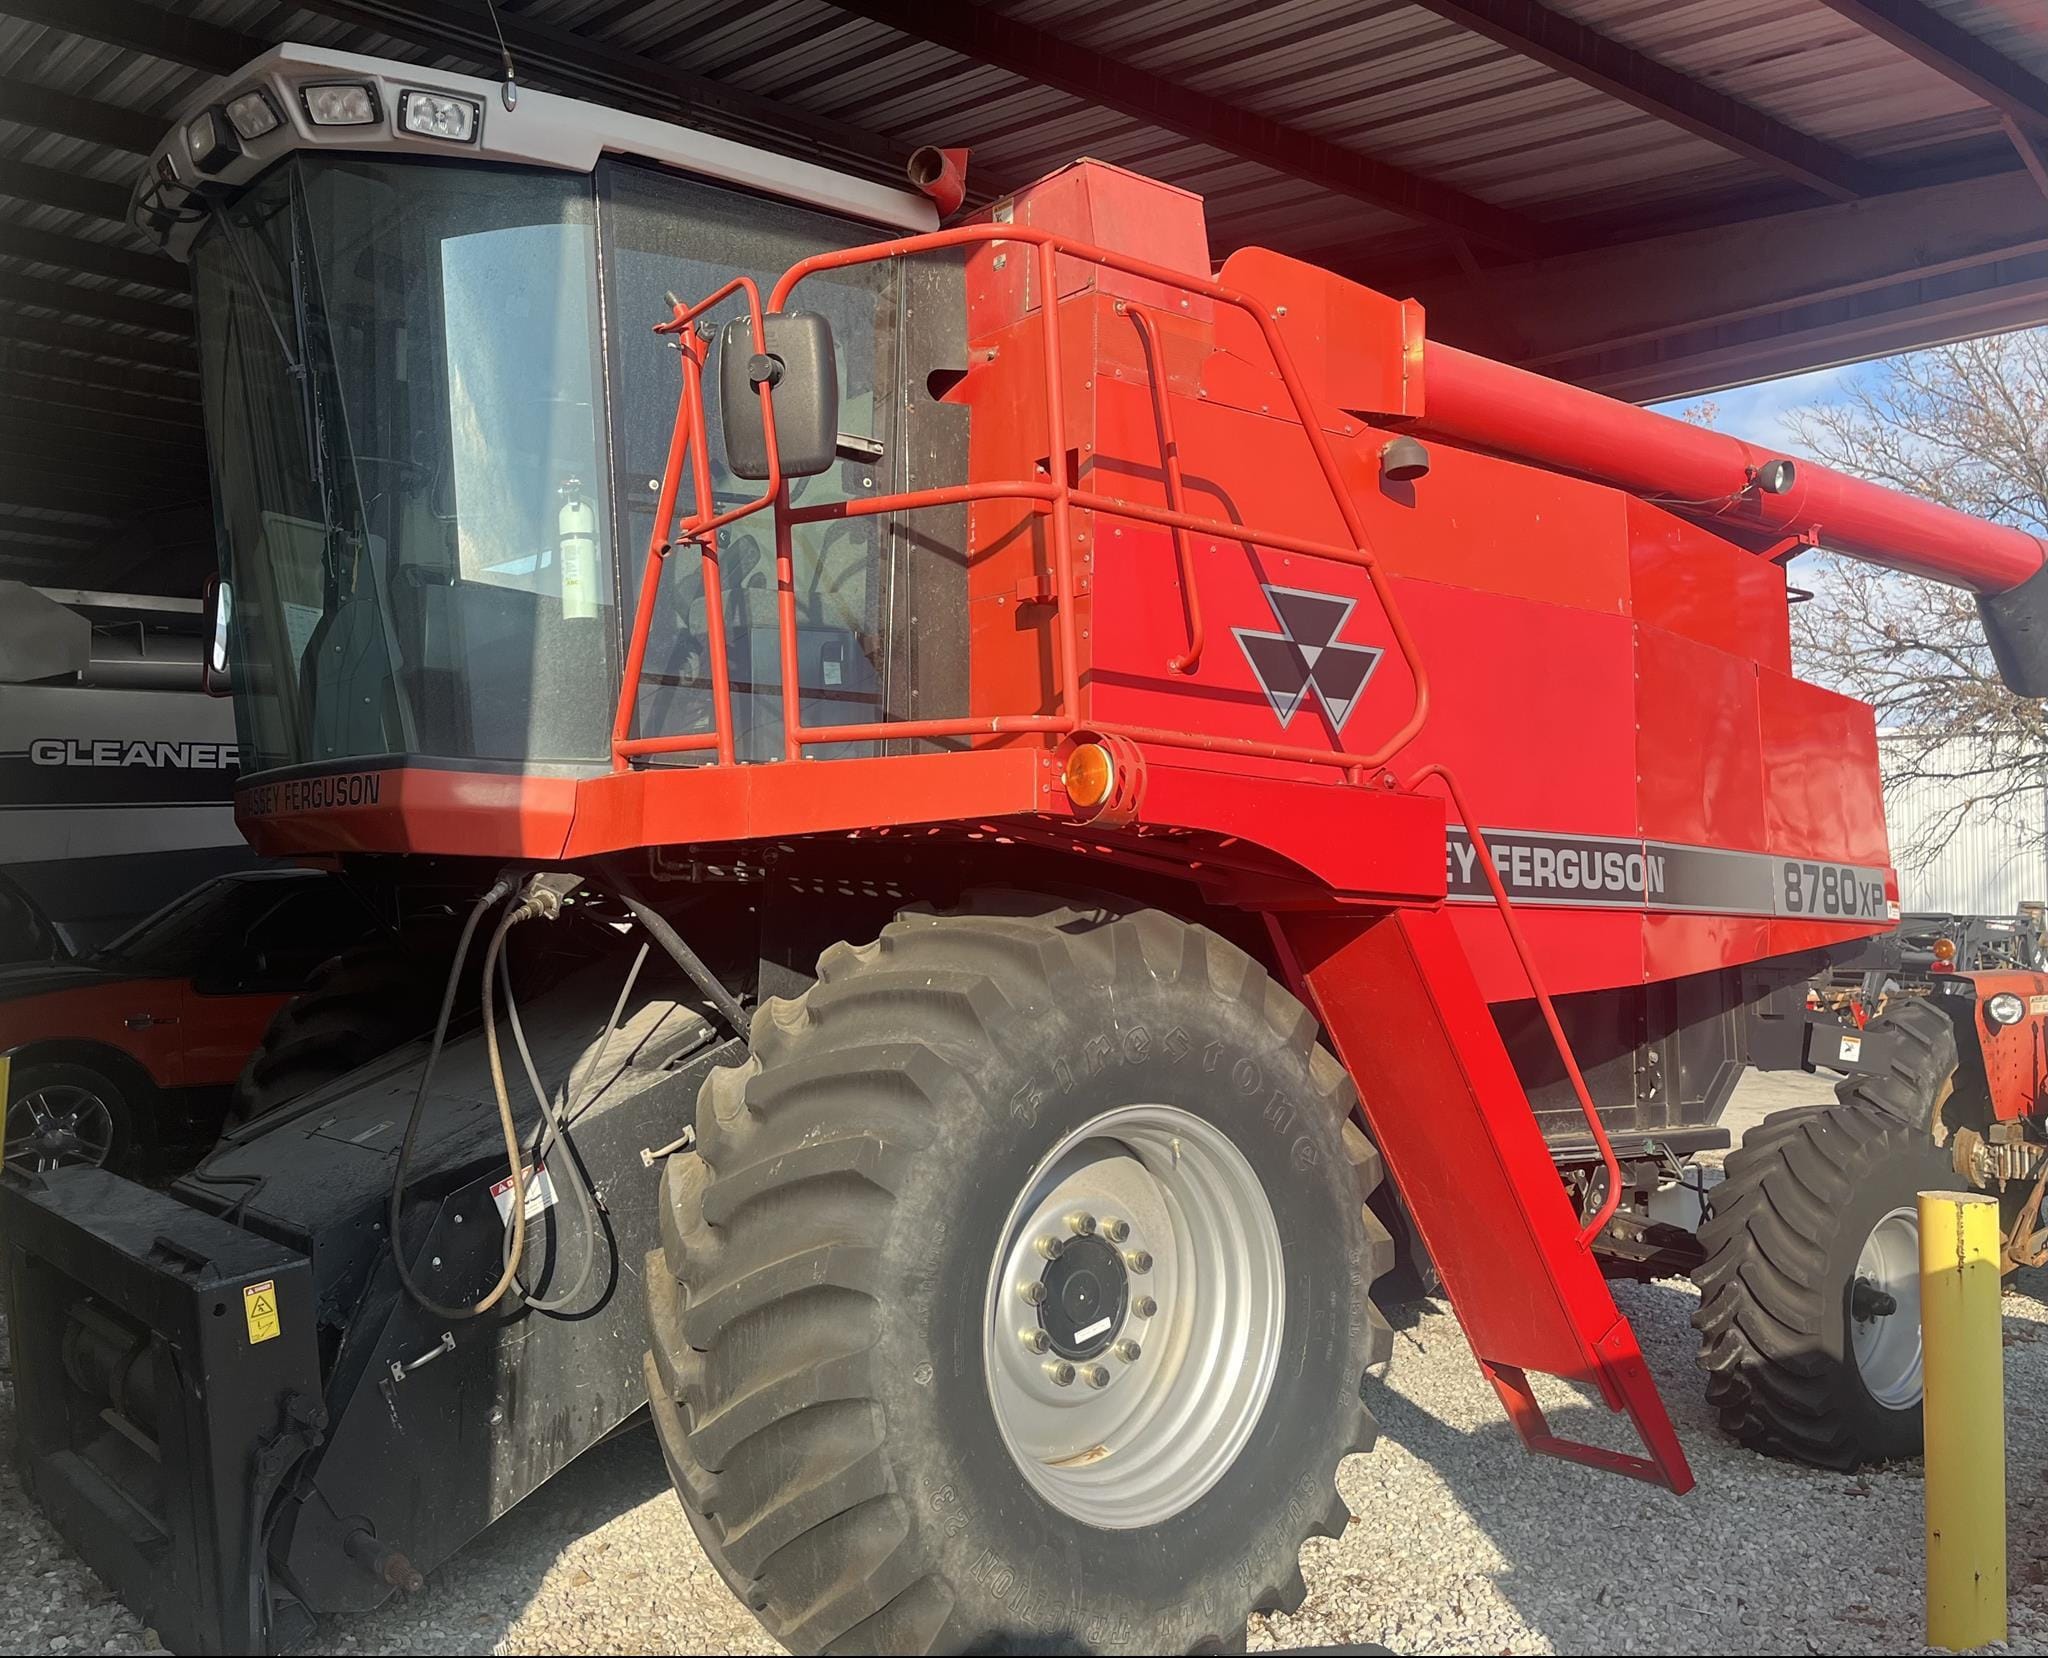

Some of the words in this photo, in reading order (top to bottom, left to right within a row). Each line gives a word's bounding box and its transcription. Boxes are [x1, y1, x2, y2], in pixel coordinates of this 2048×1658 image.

[31, 740, 240, 769] GLEANER
[285, 774, 380, 810] FERGUSON
[1491, 844, 1665, 894] FERGUSON
[1010, 1026, 1318, 1173] Firestone
[1233, 1472, 1319, 1590] SUPER
[968, 1547, 1131, 1646] TRACTION
[1155, 1598, 1217, 1639] ALL
